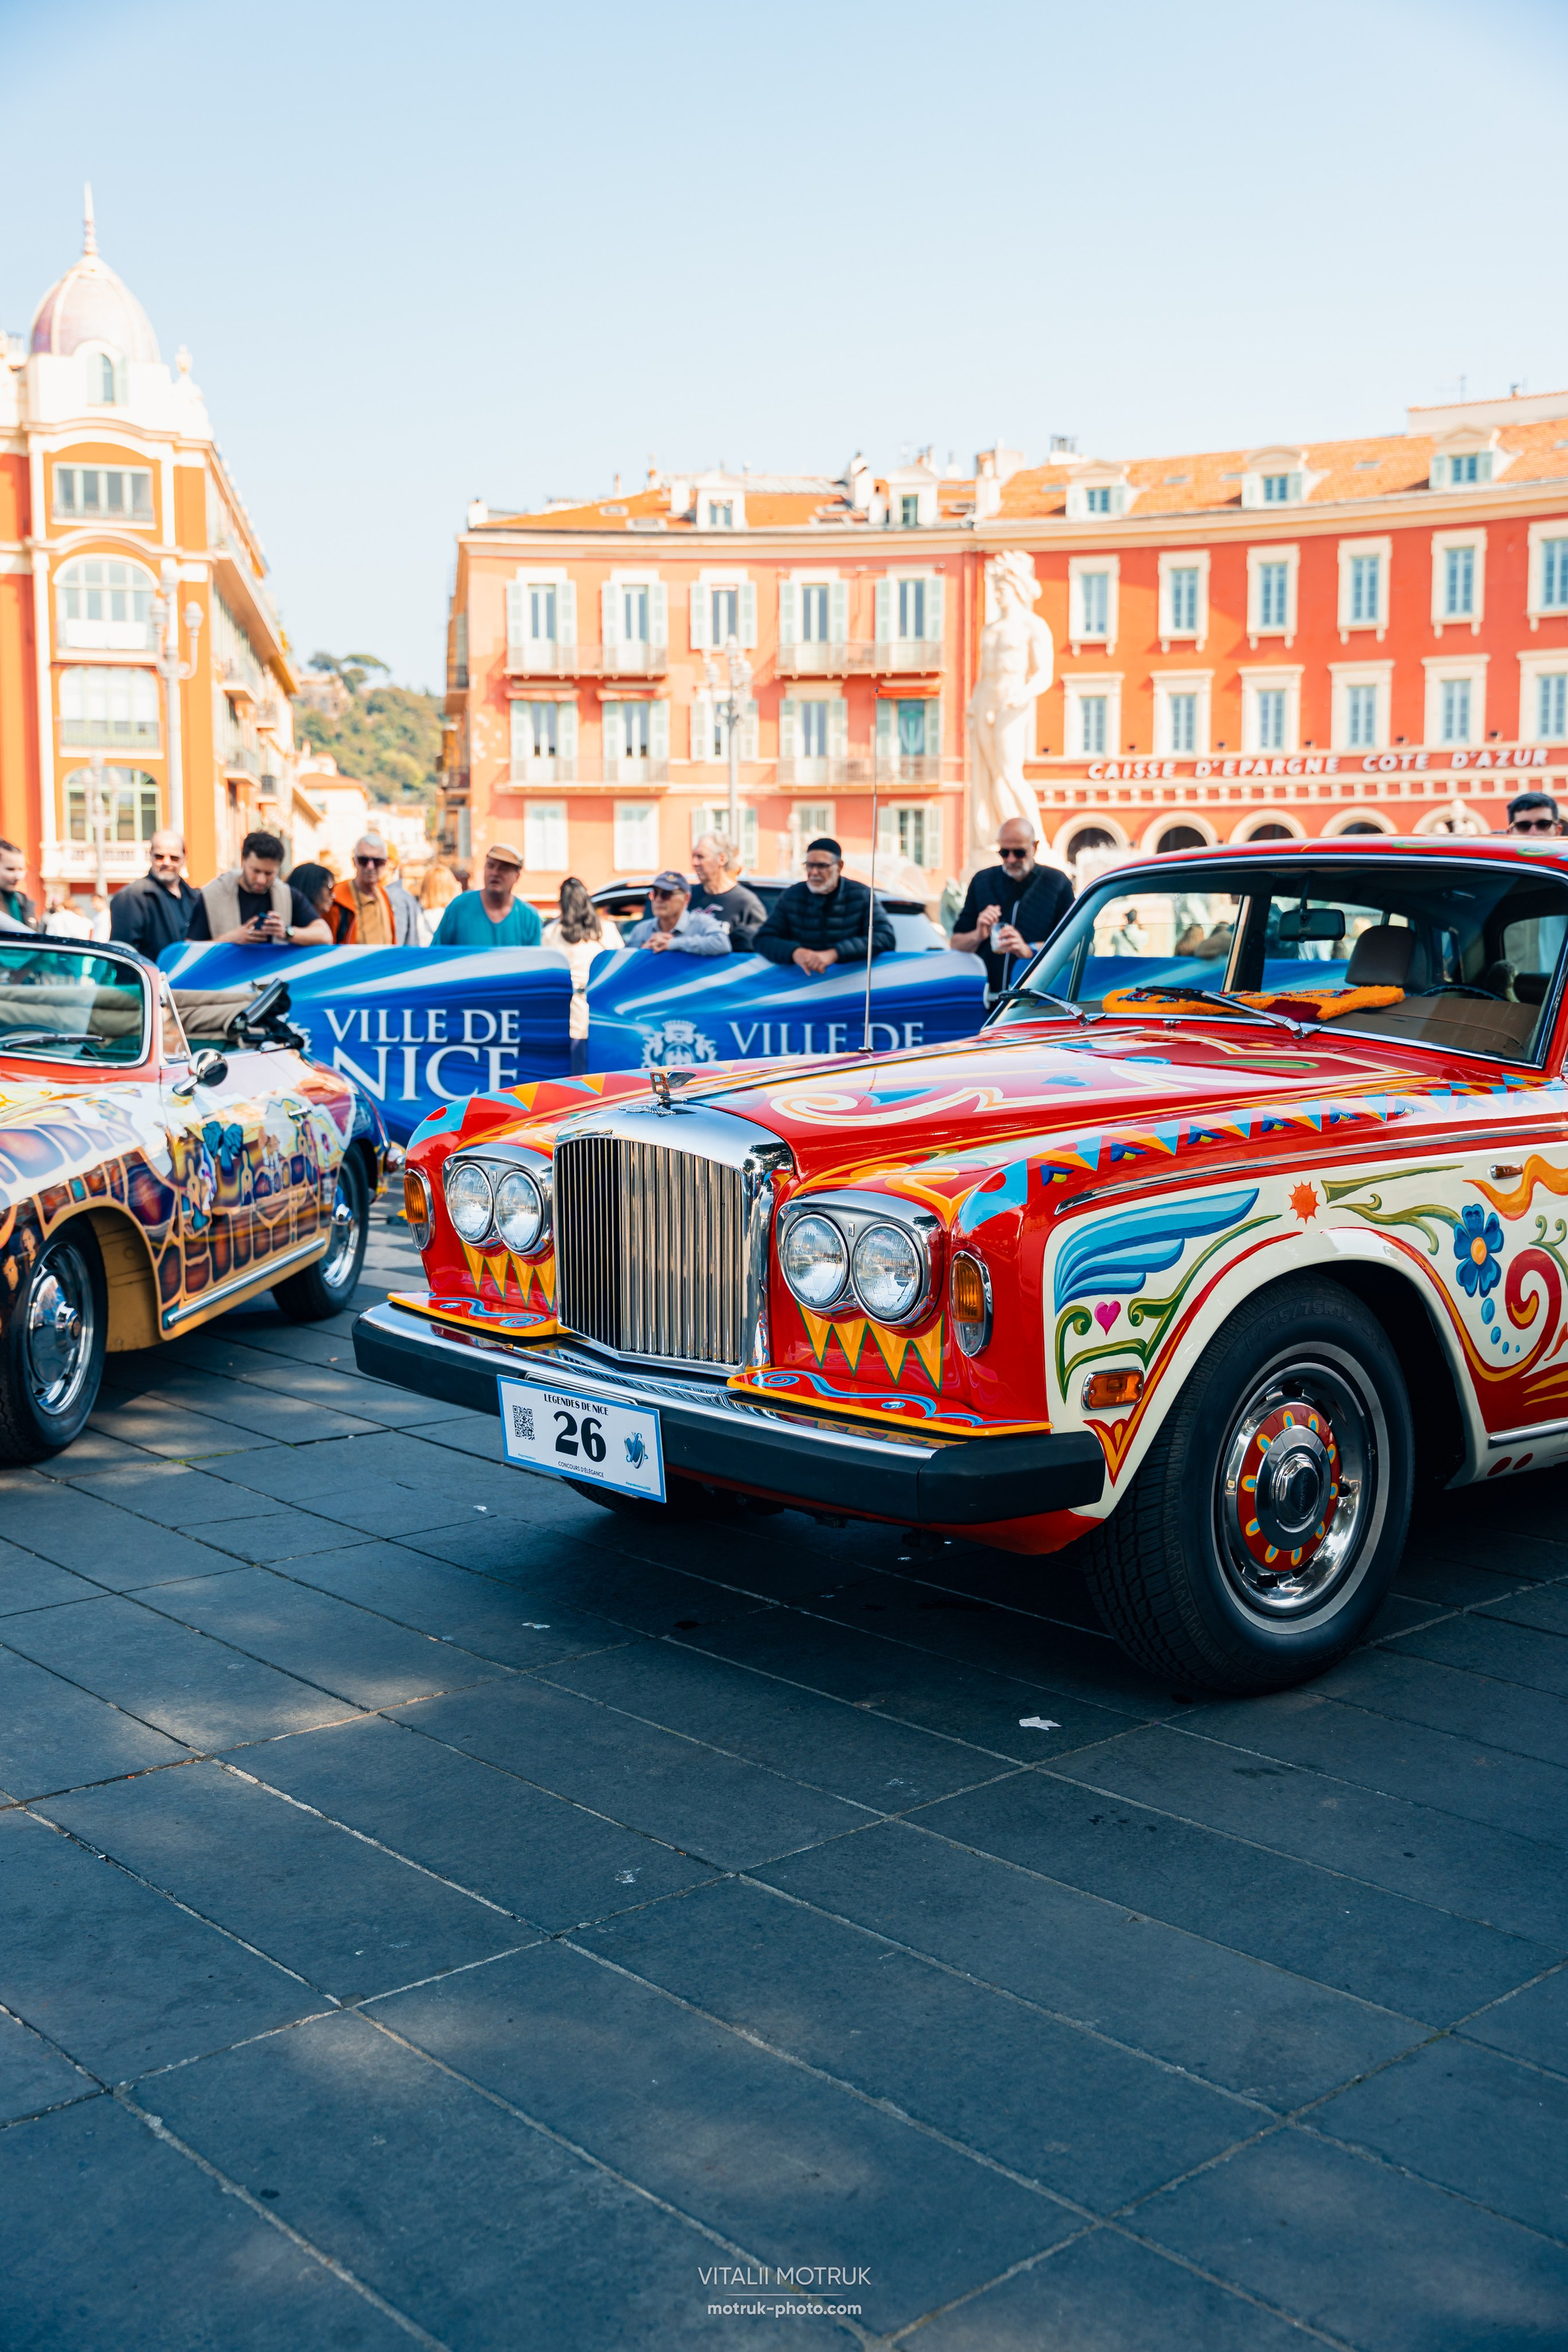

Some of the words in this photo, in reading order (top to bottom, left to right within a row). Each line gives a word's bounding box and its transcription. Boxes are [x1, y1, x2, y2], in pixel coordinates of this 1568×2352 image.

[1088, 761, 1177, 780] CAISSE
[1194, 755, 1341, 778] D'EPARGNE
[1451, 748, 1548, 769] D'AZUR
[323, 1009, 448, 1042] VILLE
[461, 1009, 520, 1044] DE
[727, 1021, 848, 1056] VILLE
[861, 1020, 924, 1050] DE
[333, 1044, 519, 1101] NICE
[544, 1393, 580, 1409] LEGENDES
[581, 1401, 591, 1412] DE
[592, 1404, 609, 1416] NICE
[553, 1410, 607, 1463] 26
[558, 1461, 581, 1472] CONCOURS
[580, 1466, 605, 1478] D'ÉLÉGANCE
